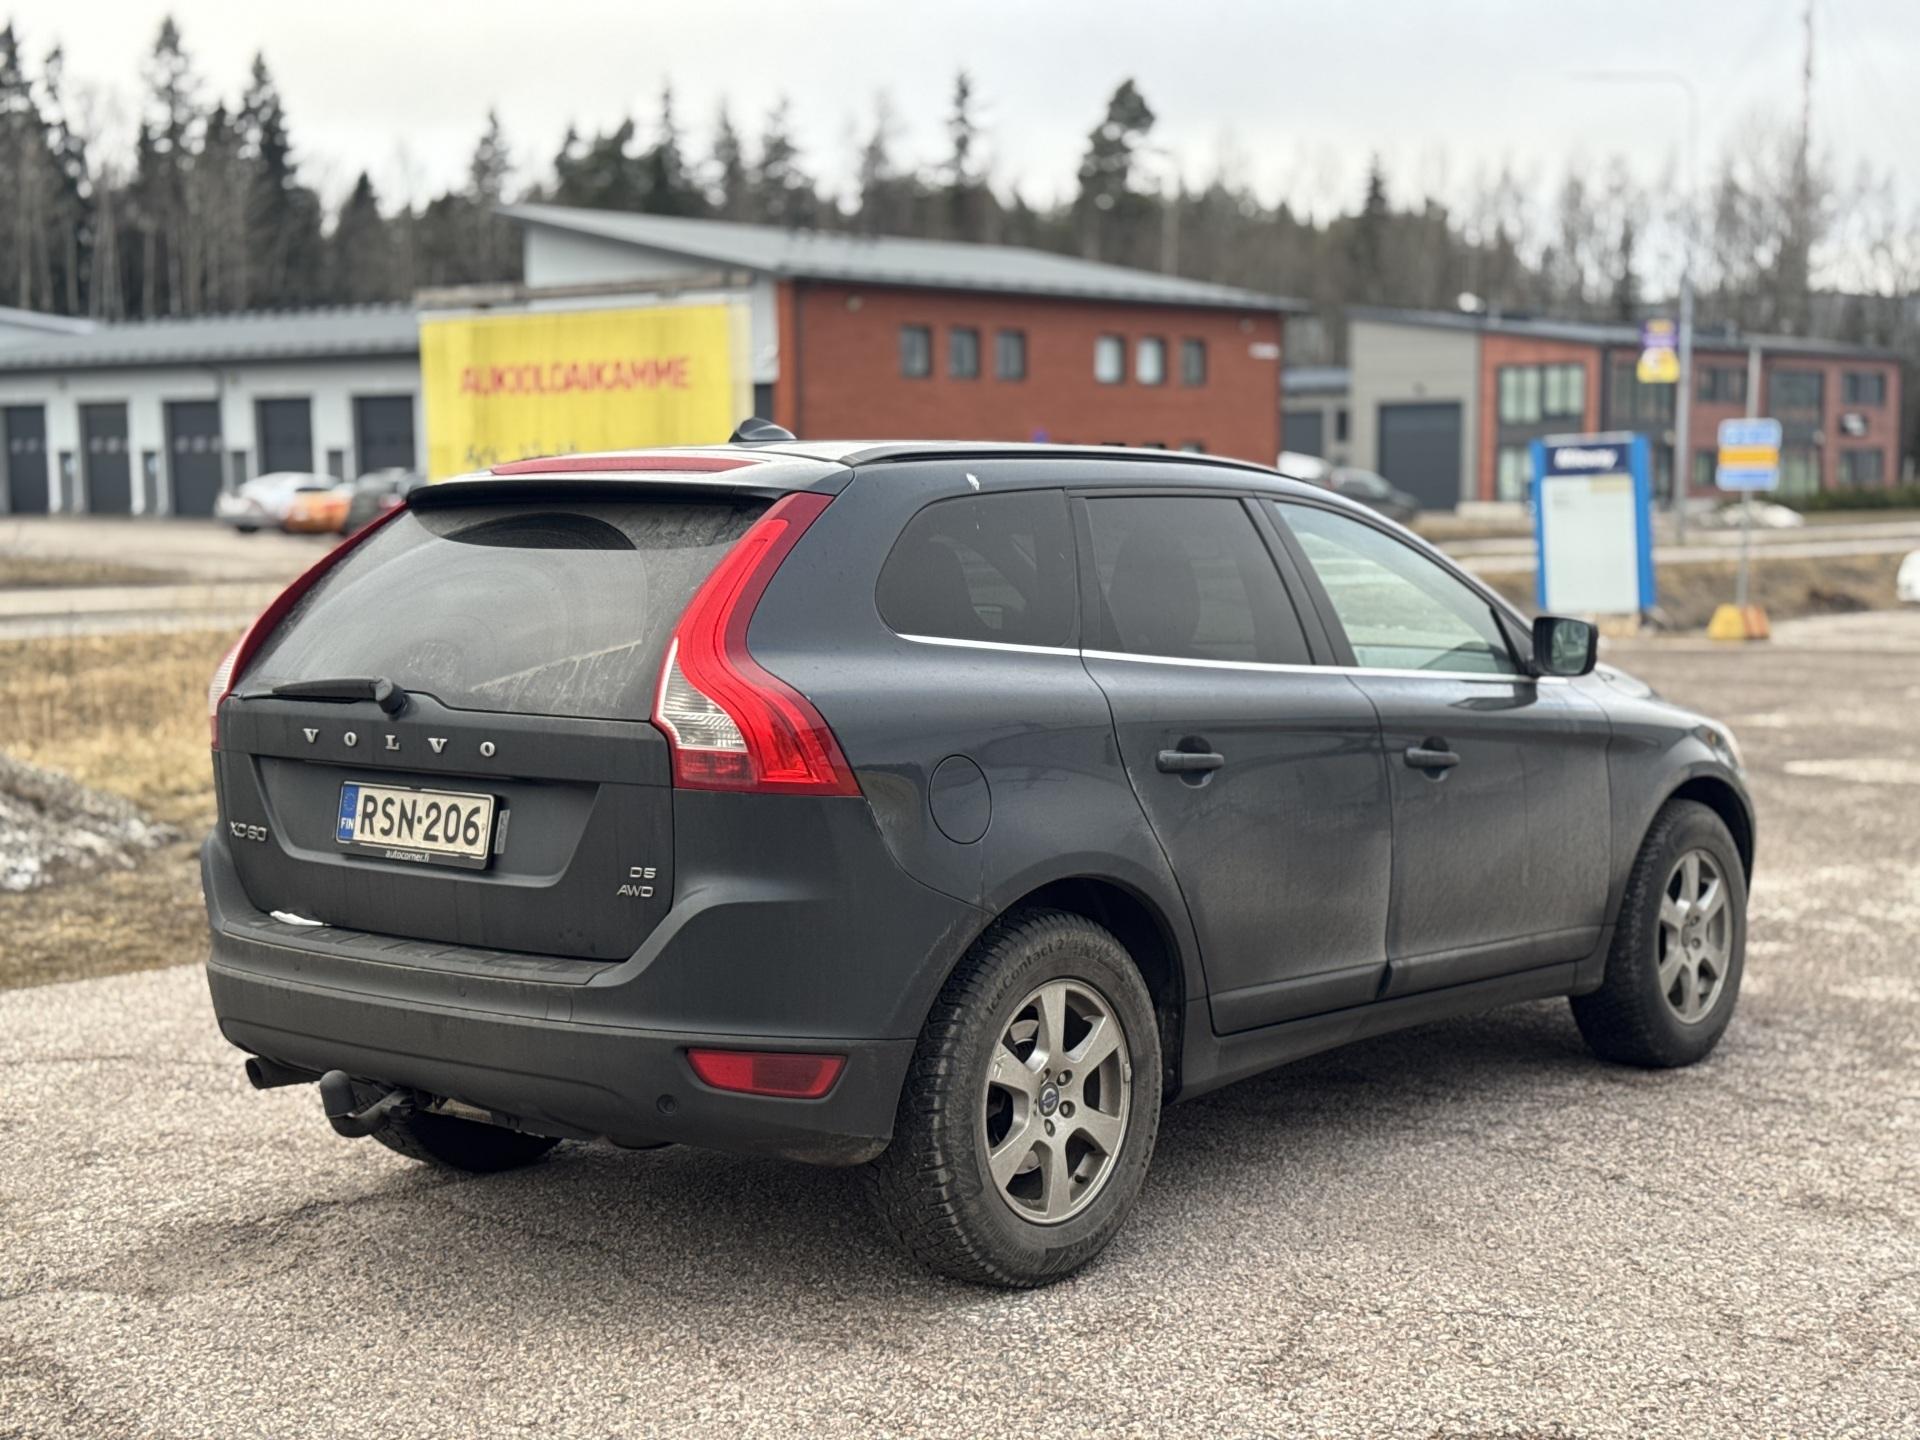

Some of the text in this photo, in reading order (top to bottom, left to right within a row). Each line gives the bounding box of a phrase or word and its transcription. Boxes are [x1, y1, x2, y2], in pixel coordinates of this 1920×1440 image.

[303, 727, 496, 758] VOLVO
[340, 816, 354, 830] FIN
[359, 793, 482, 847] RSN-206
[230, 820, 267, 842] XC60
[385, 849, 430, 863] autocorner.fi
[629, 866, 657, 879] D5
[616, 884, 654, 897] AWD
[985, 942, 1054, 1016] IceContact
[1057, 937, 1066, 951] 2
